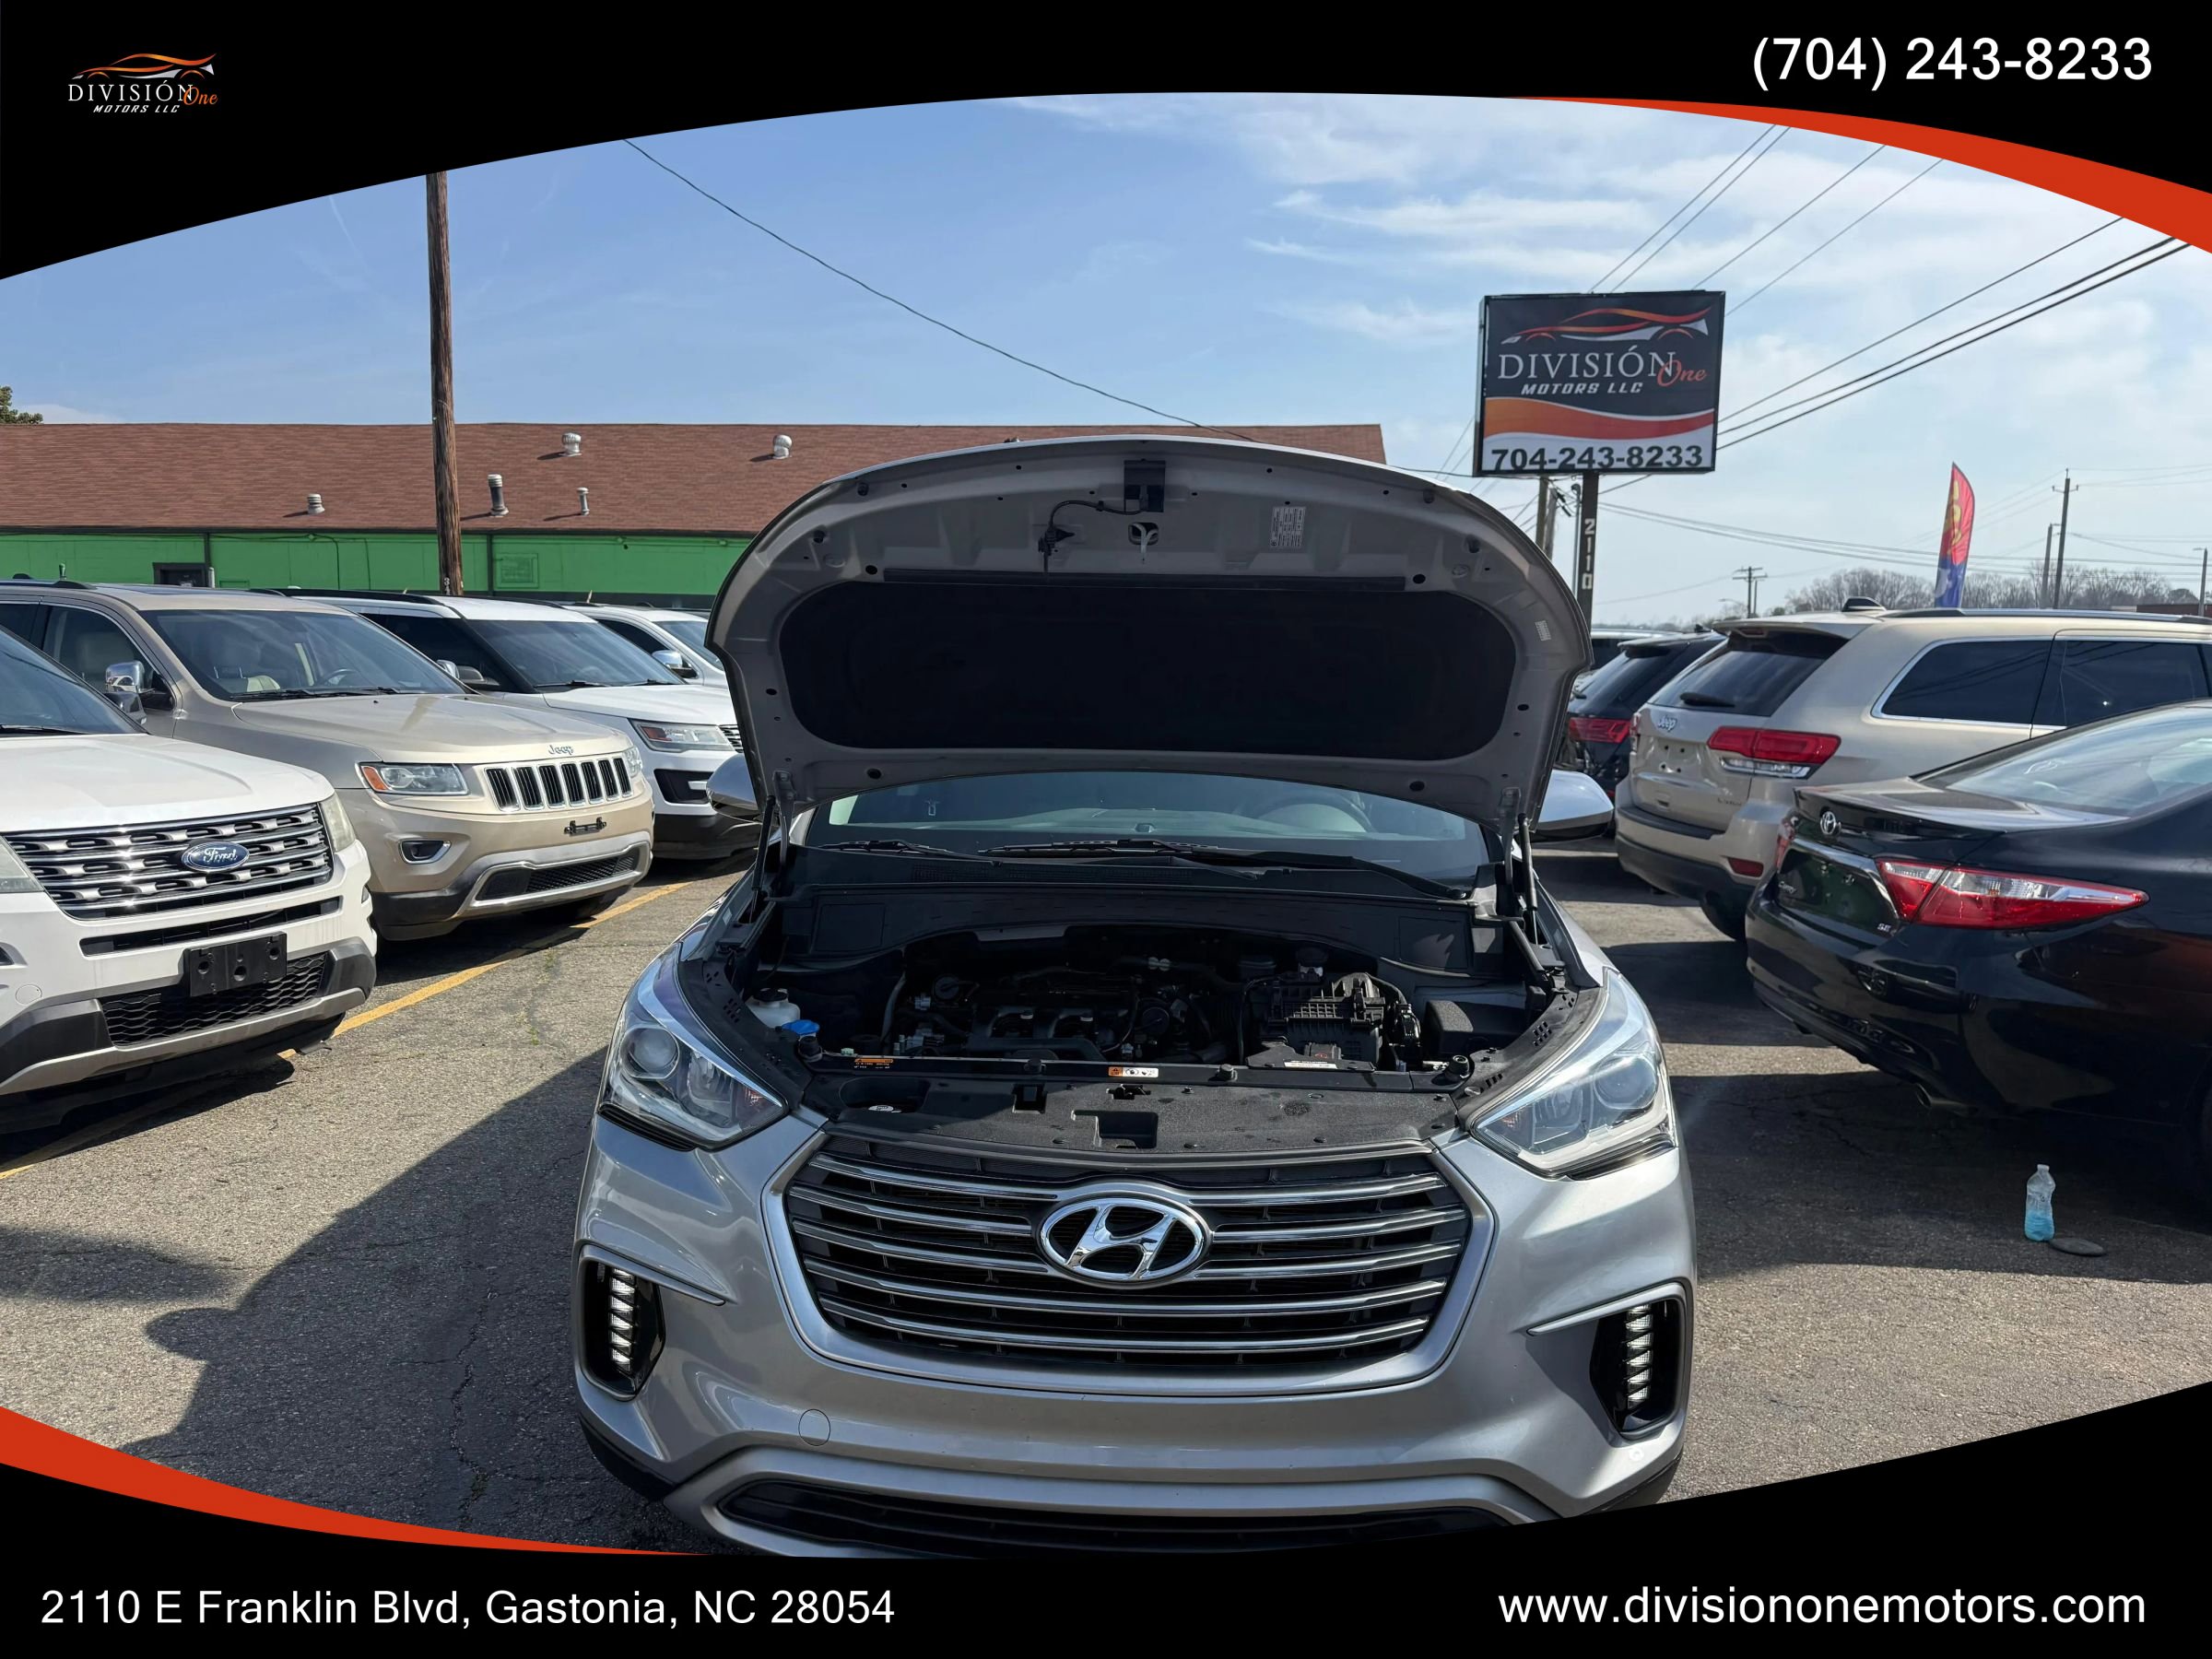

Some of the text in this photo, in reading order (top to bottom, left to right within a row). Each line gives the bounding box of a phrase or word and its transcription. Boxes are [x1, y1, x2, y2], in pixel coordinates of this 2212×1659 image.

[1498, 345, 1676, 379] DIVISIÓN
[1657, 359, 1708, 386] One
[1521, 382, 1643, 395] MOTORS LLC
[1490, 444, 1703, 470] 704-243-8233
[1582, 518, 1596, 590] 2110
[548, 745, 574, 756] Jeep
[203, 846, 238, 863] Ford
